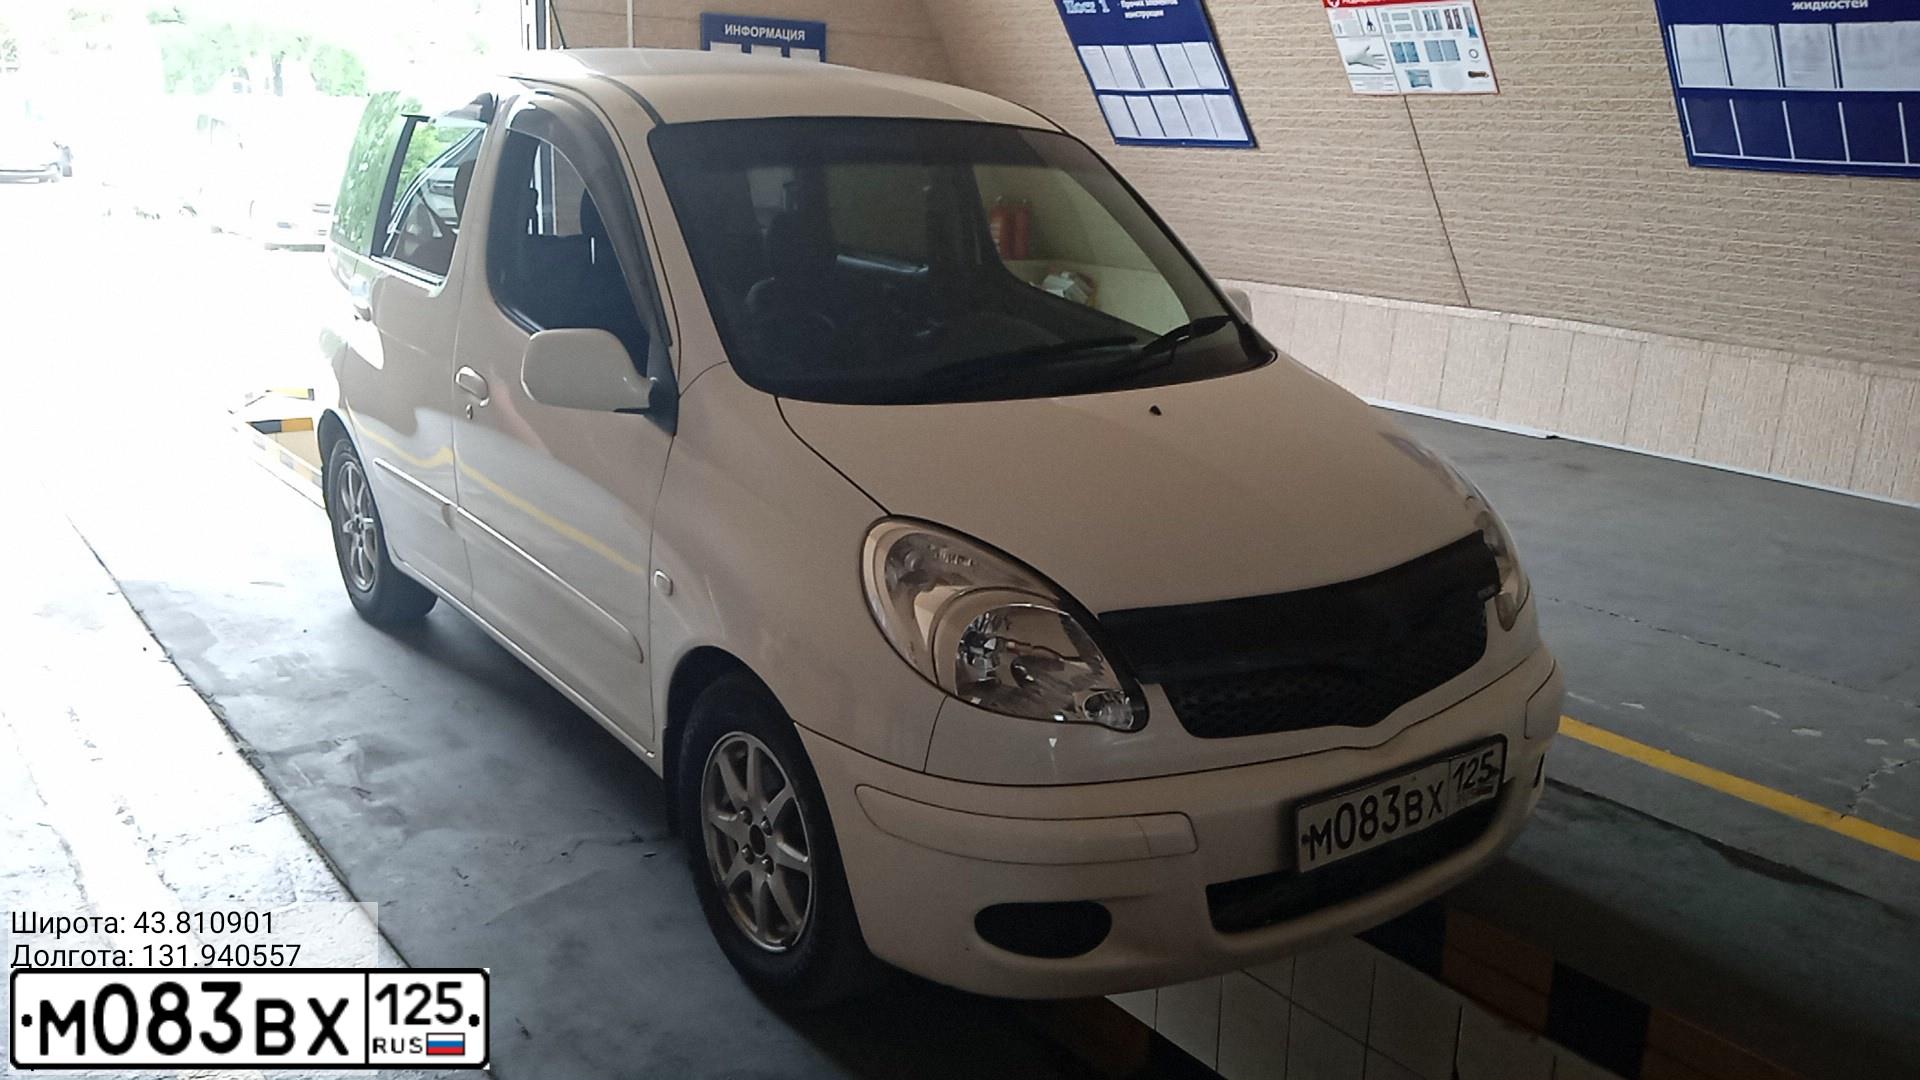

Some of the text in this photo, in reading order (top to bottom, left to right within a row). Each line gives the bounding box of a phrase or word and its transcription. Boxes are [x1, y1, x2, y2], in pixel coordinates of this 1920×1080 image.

[724, 23, 806, 42] ИНФОРМАЦИЯ
[1310, 751, 1495, 862] М083ВХ 125
